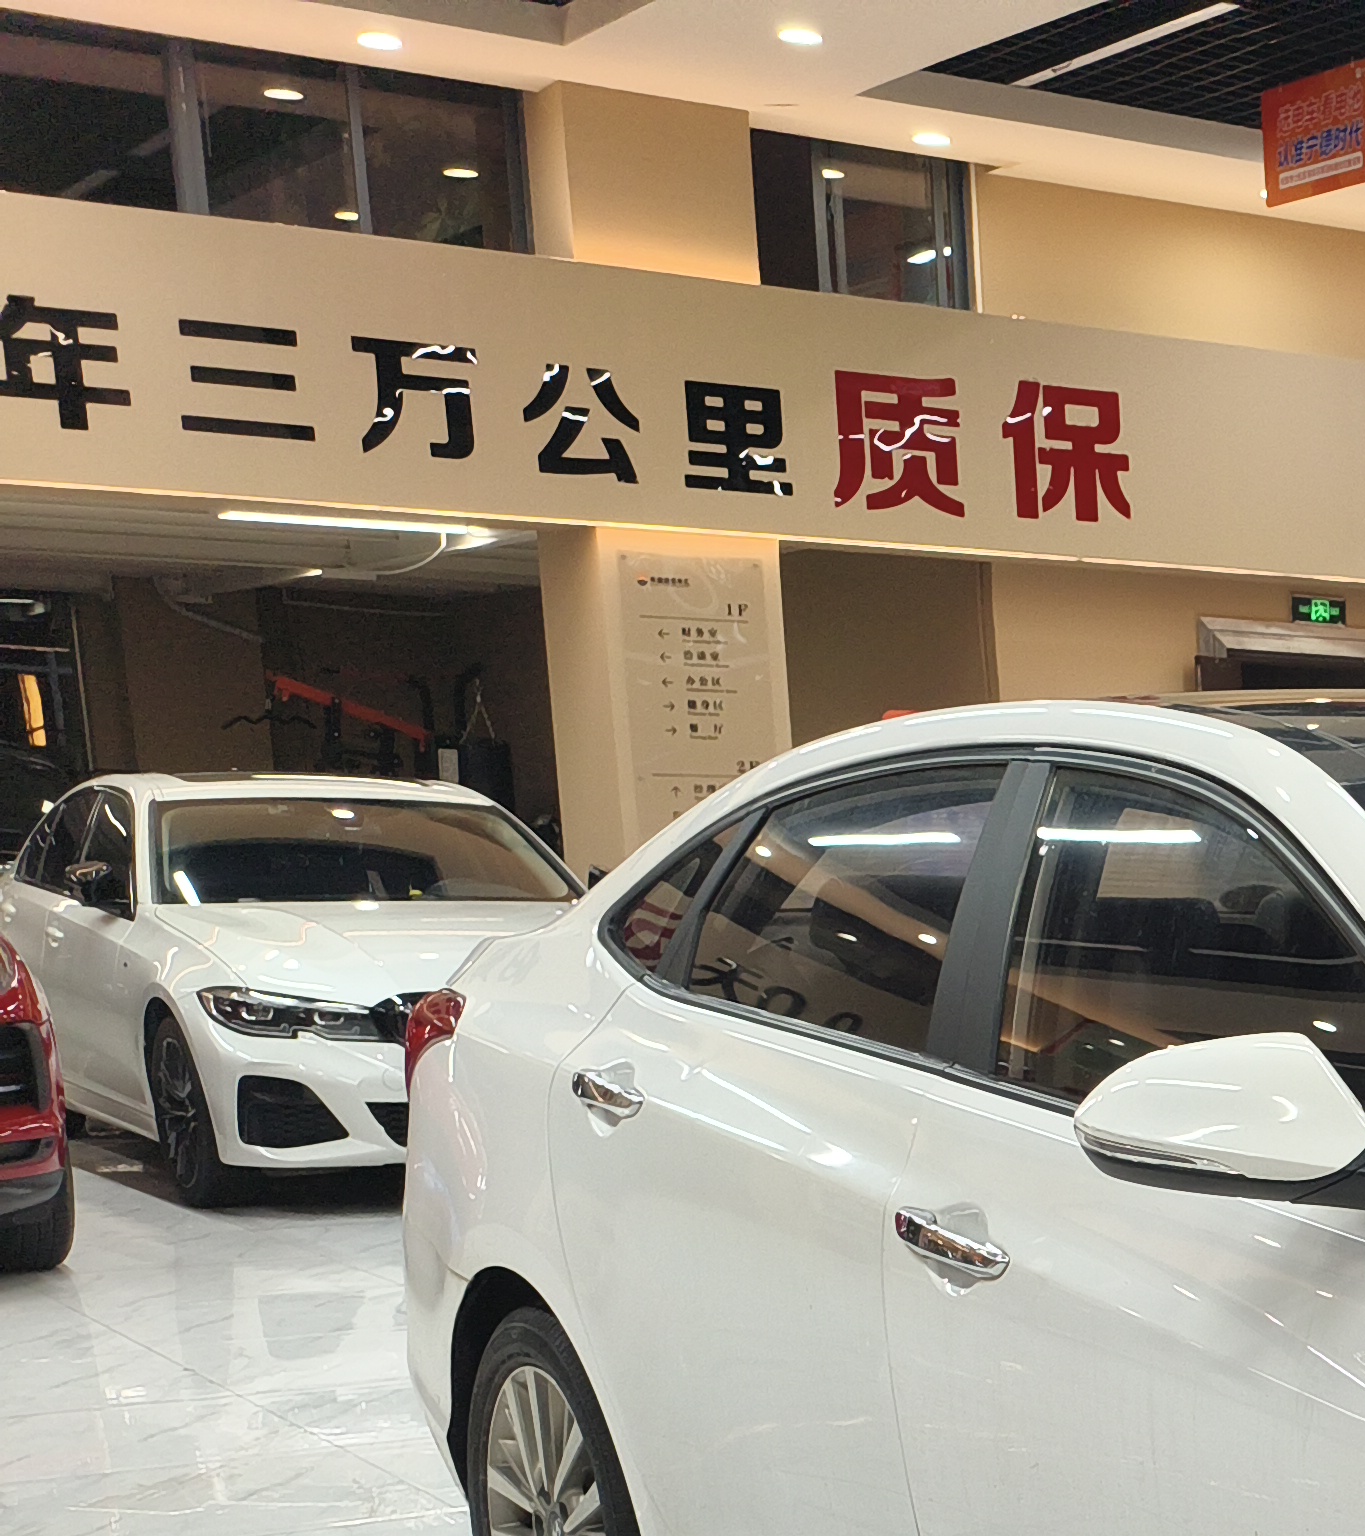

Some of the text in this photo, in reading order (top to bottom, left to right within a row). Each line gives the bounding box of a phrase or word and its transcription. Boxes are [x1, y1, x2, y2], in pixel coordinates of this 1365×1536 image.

[1277, 117, 1364, 169] 认准宁德时代
